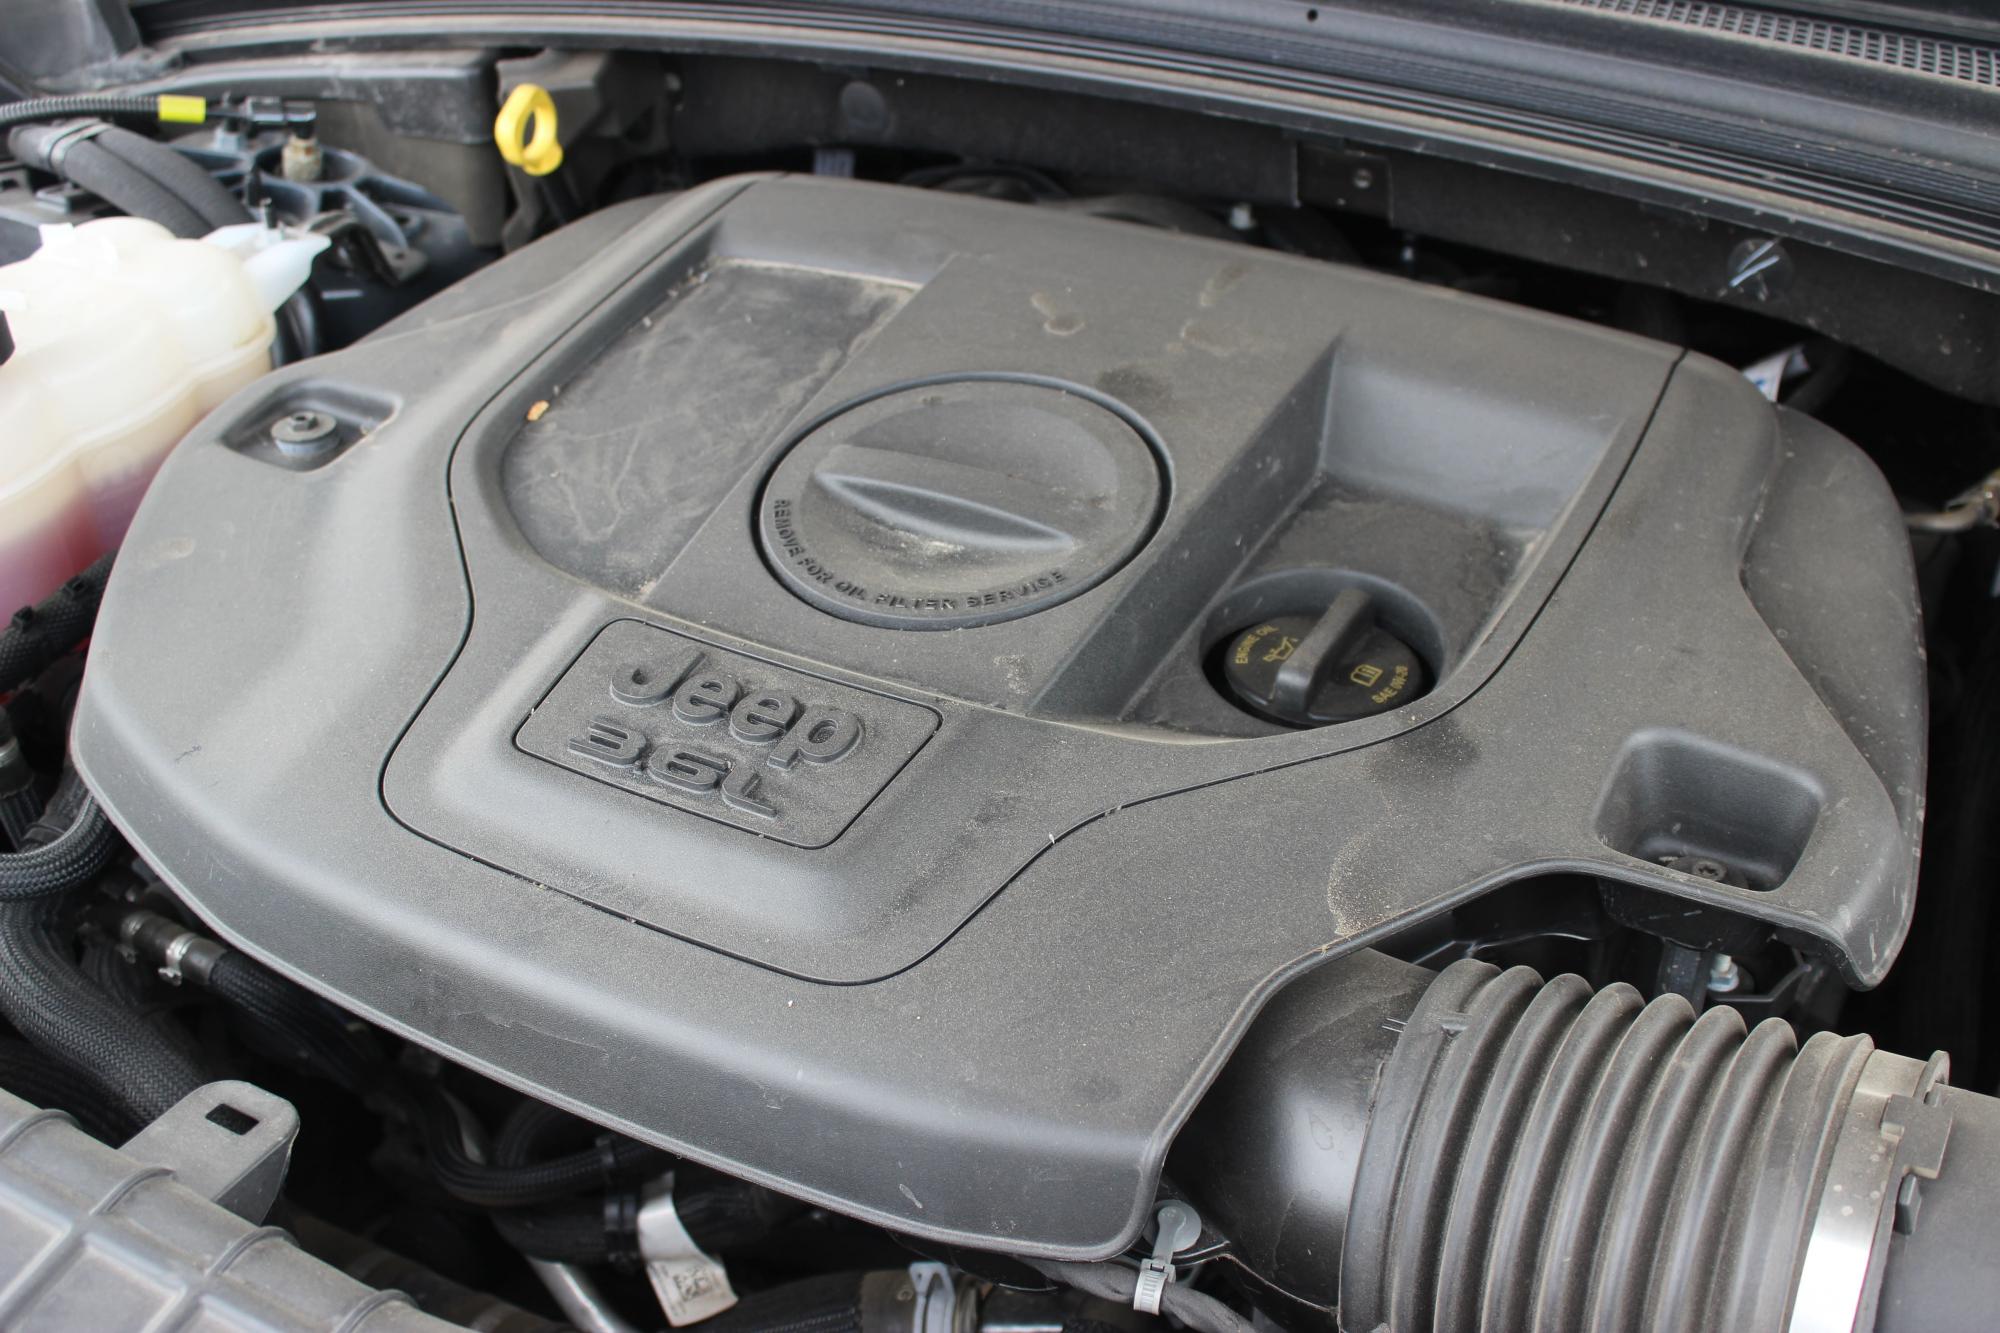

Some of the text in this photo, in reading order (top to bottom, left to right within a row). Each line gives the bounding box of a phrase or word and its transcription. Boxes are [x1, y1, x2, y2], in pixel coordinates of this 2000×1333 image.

[774, 499, 806, 557] REMOVE
[797, 557, 834, 584] FOR
[835, 582, 867, 600] OIL
[875, 593, 955, 610] FILTER
[1235, 625, 1280, 665] ENGINE OIL
[610, 651, 862, 769] Jeep
[1372, 687, 1398, 704] SAE
